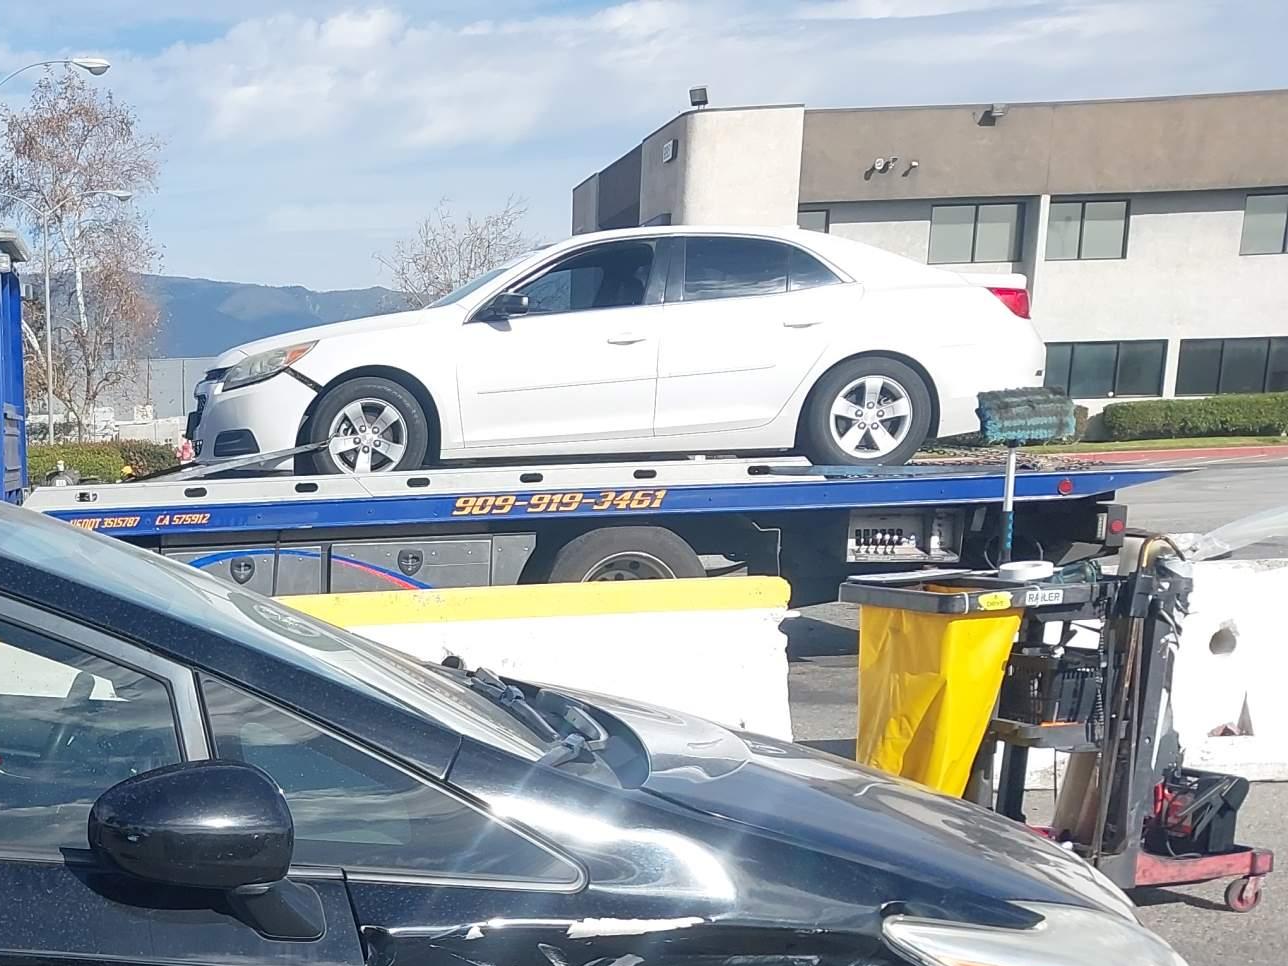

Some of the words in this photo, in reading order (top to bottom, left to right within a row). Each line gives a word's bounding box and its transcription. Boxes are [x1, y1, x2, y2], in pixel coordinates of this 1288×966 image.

[452, 489, 667, 515] 909-919-3461
[102, 516, 141, 528] 3515787
[155, 515, 170, 526] CA
[171, 513, 211, 525] 575912
